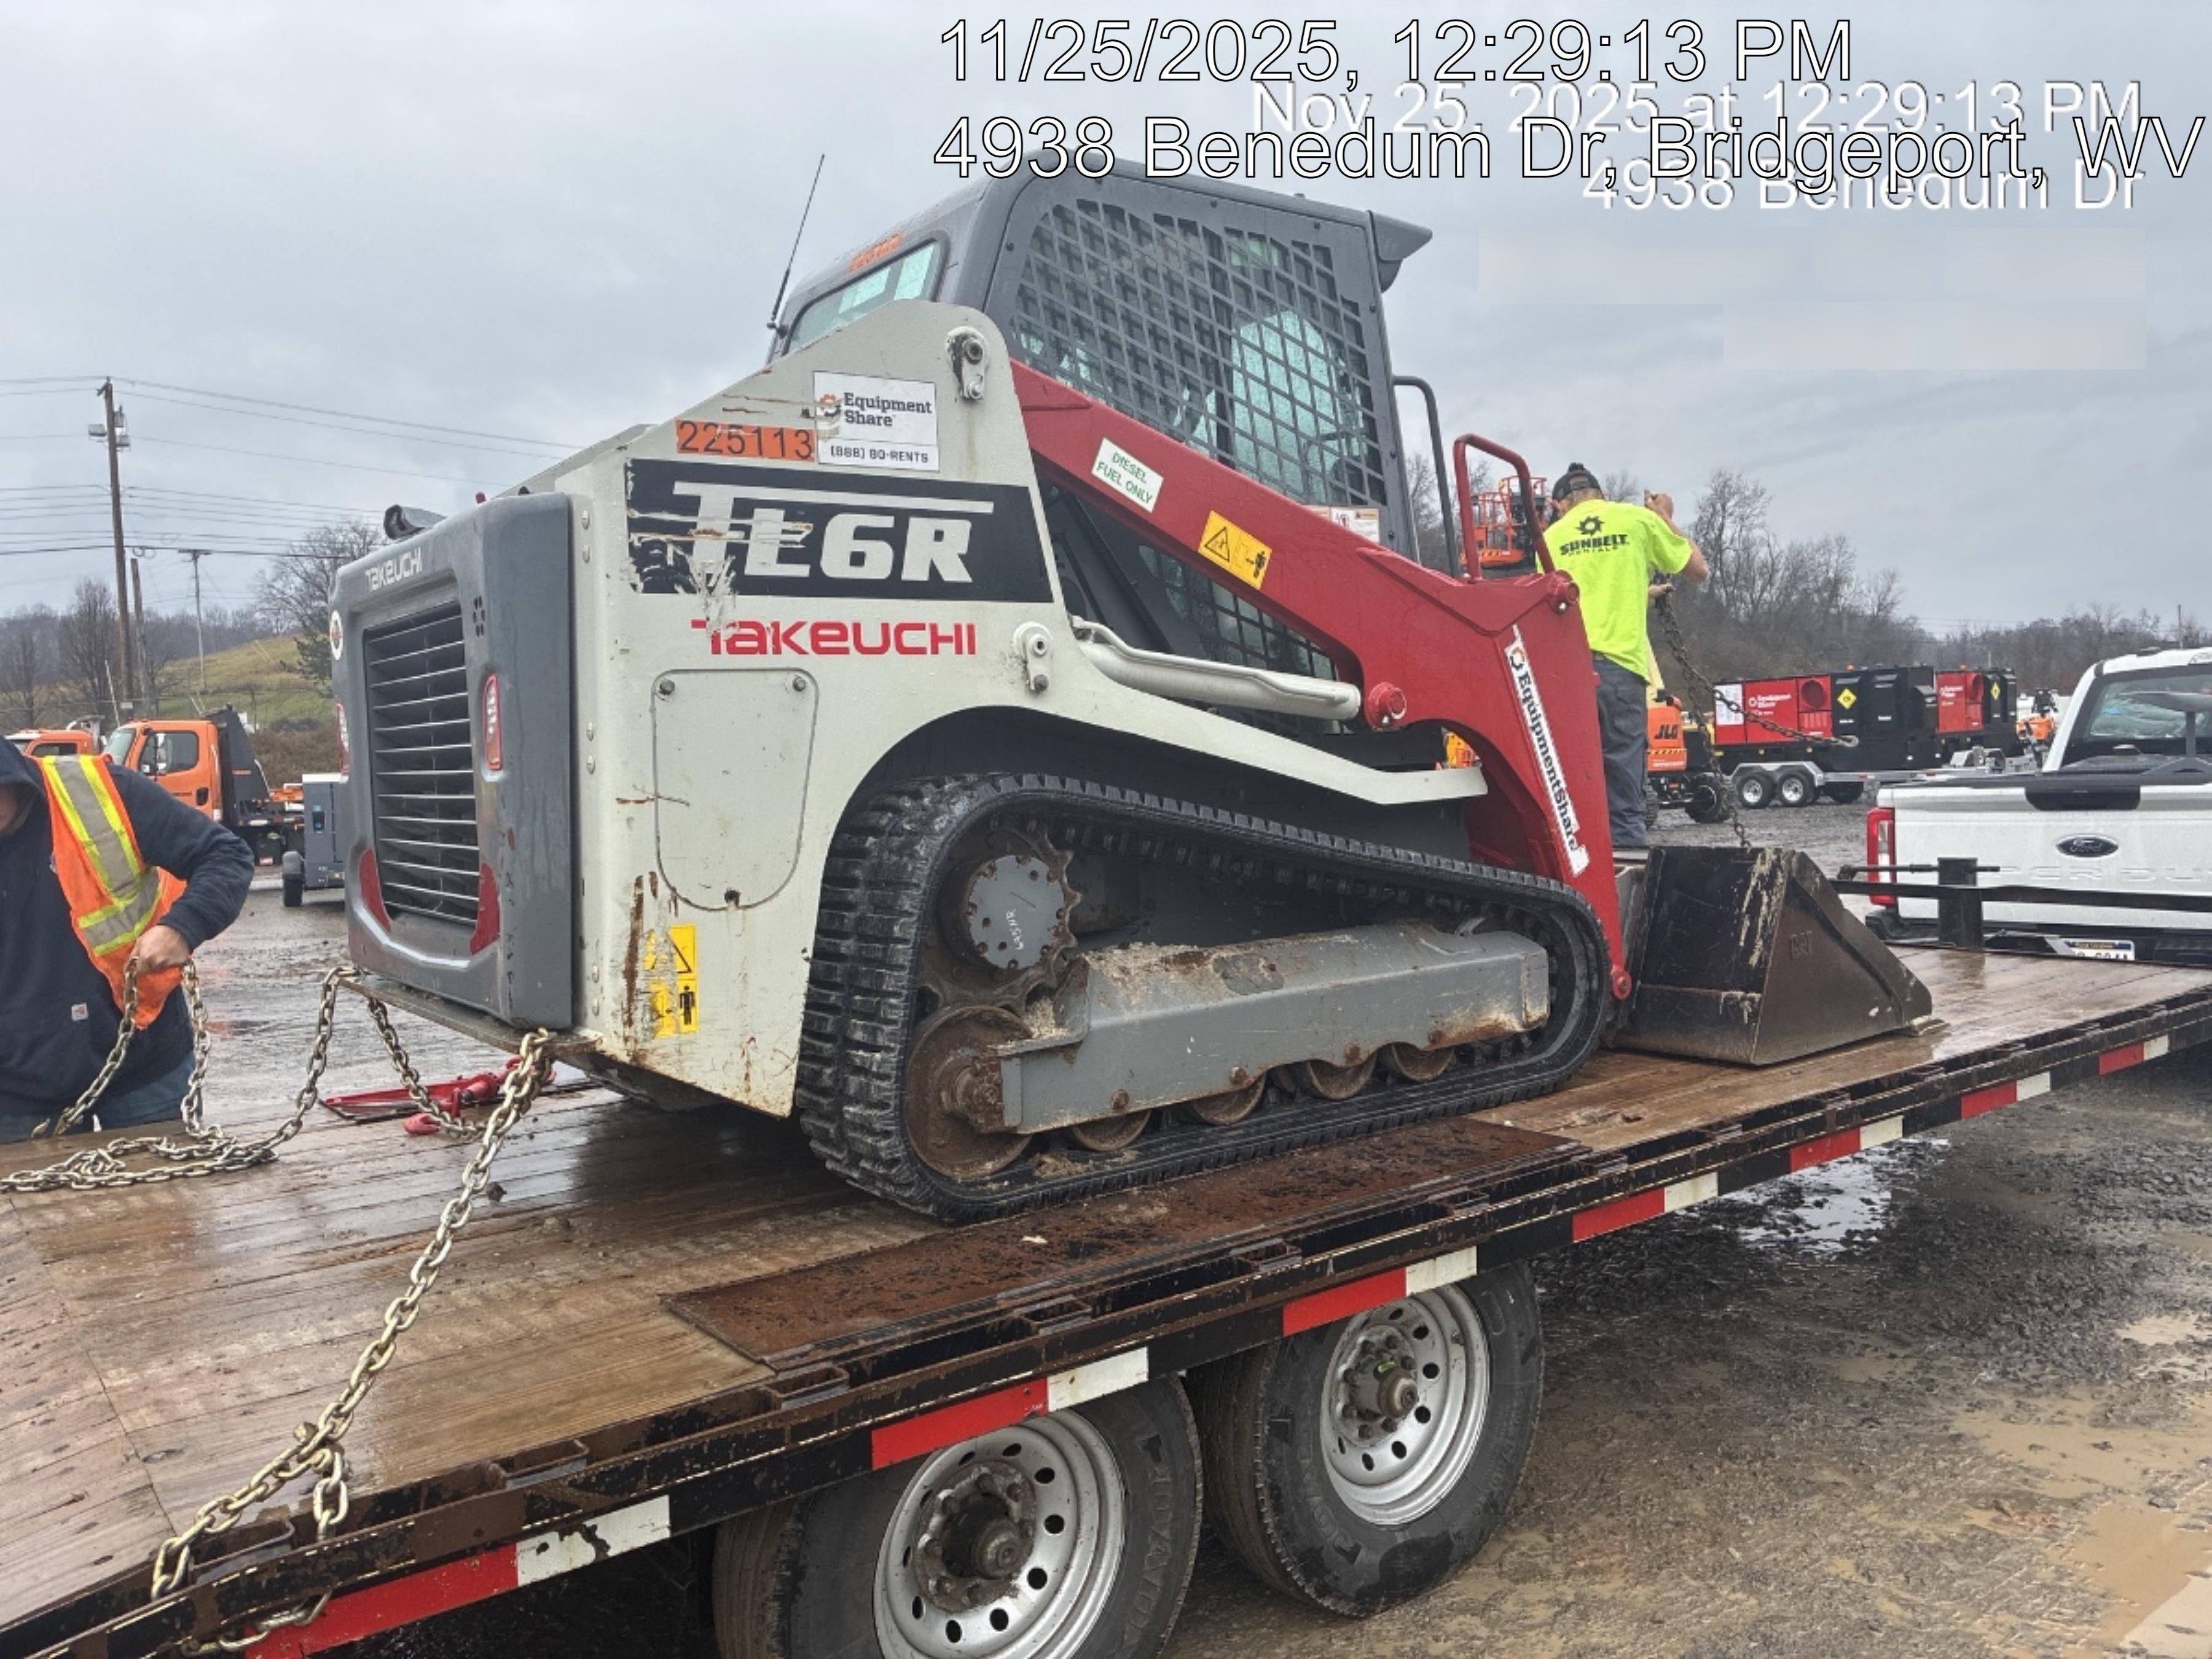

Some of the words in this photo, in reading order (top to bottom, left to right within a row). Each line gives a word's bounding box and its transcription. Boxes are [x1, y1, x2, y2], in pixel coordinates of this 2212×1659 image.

[844, 392, 933, 414] Equipment
[844, 410, 893, 426] Share
[679, 420, 812, 460] 225113
[1113, 451, 1147, 484] DIESEL
[1096, 461, 1122, 486] FUEL
[1126, 480, 1153, 504] ONLY
[1559, 534, 1628, 555] SUNBELT
